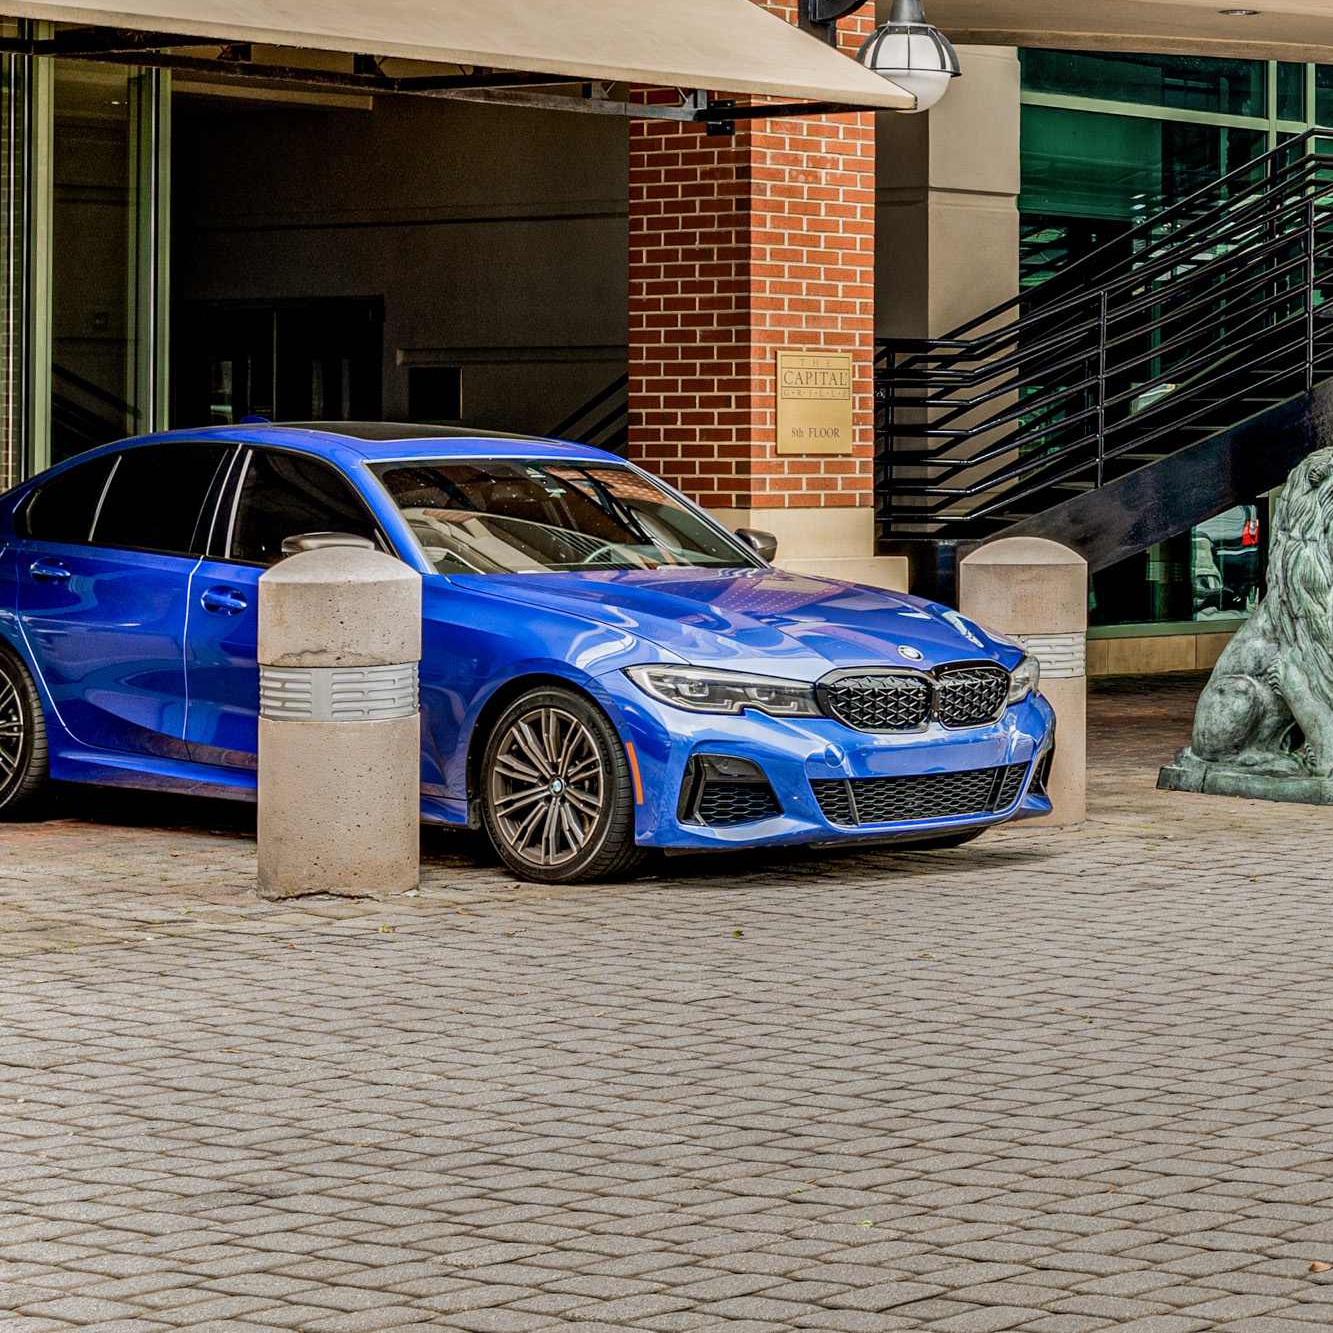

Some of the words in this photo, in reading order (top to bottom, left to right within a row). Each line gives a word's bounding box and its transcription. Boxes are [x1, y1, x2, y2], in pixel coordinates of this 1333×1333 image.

[800, 358, 831, 367] THE
[783, 370, 848, 386] CAPITAL
[791, 427, 804, 438] 8th
[808, 427, 840, 438] FLOOR
